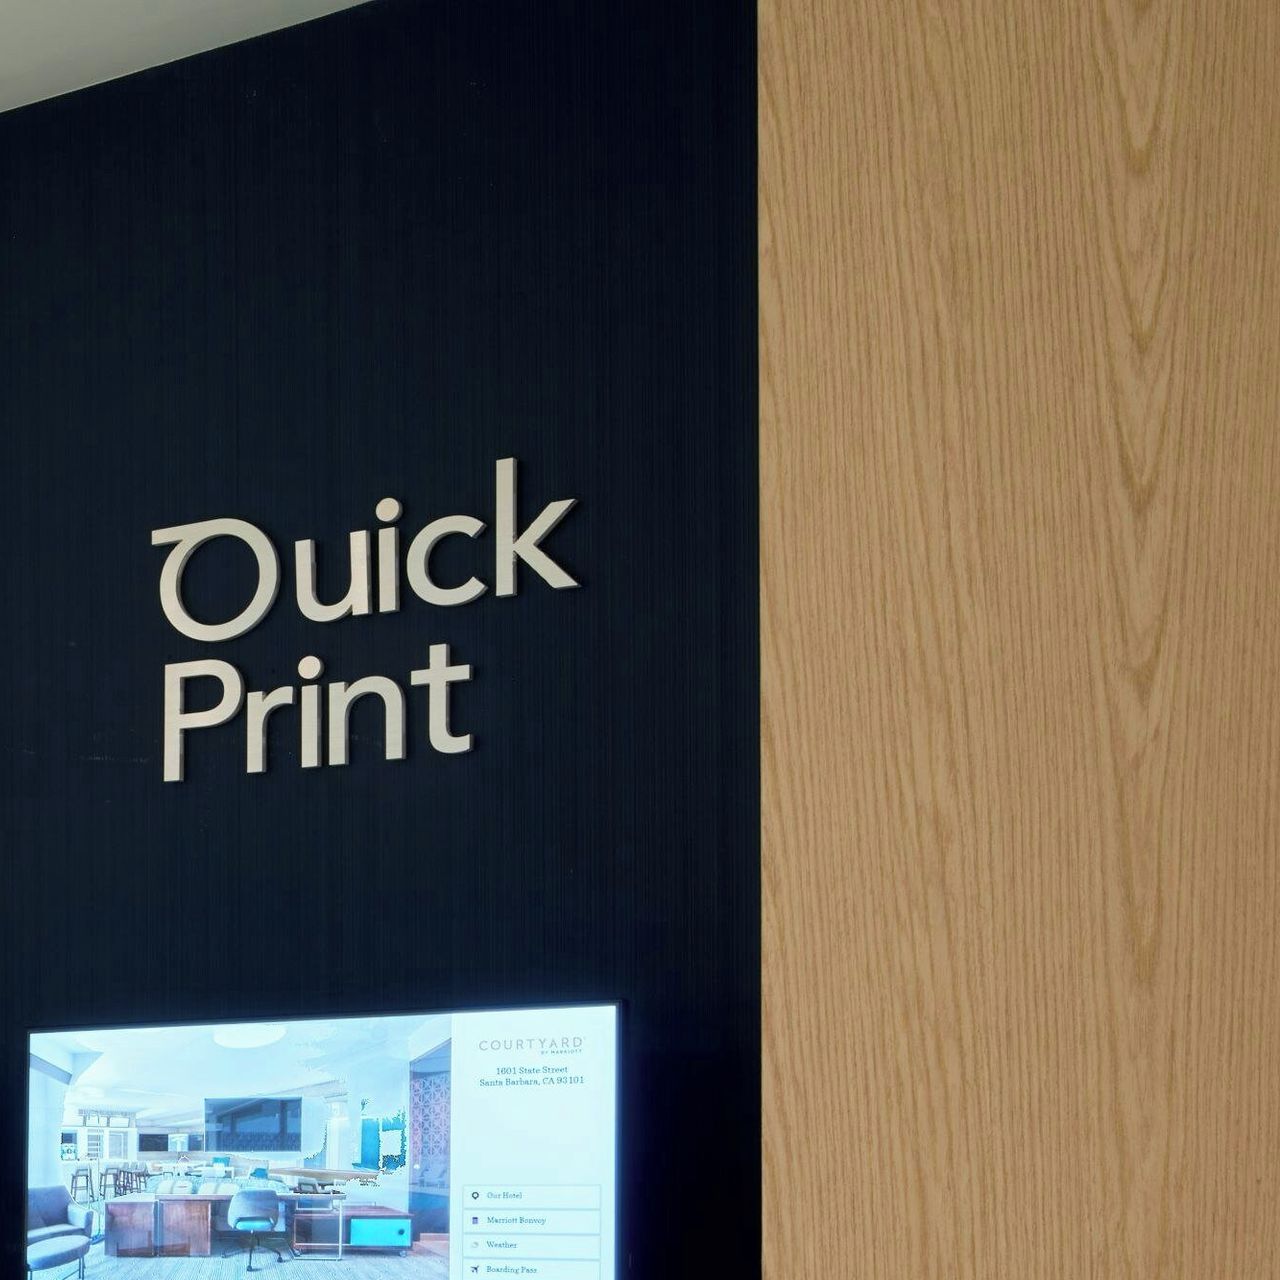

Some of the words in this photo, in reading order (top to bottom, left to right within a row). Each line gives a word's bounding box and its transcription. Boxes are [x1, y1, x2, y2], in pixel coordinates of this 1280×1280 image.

[151, 456, 582, 643] Quick
[162, 642, 474, 783] Print
[479, 1037, 583, 1051] COURTYARD
[519, 1067, 541, 1075] State
[542, 1066, 568, 1074] Street
[479, 1079, 503, 1087] Santa
[542, 1077, 555, 1085] CA
[556, 1076, 584, 1085] 93101
[502, 1191, 522, 1199] Hotel
[486, 1216, 518, 1224] Marriott
[486, 1240, 517, 1249] Weather
[486, 1265, 519, 1274] Boarding
[521, 1266, 537, 1274] Pass
